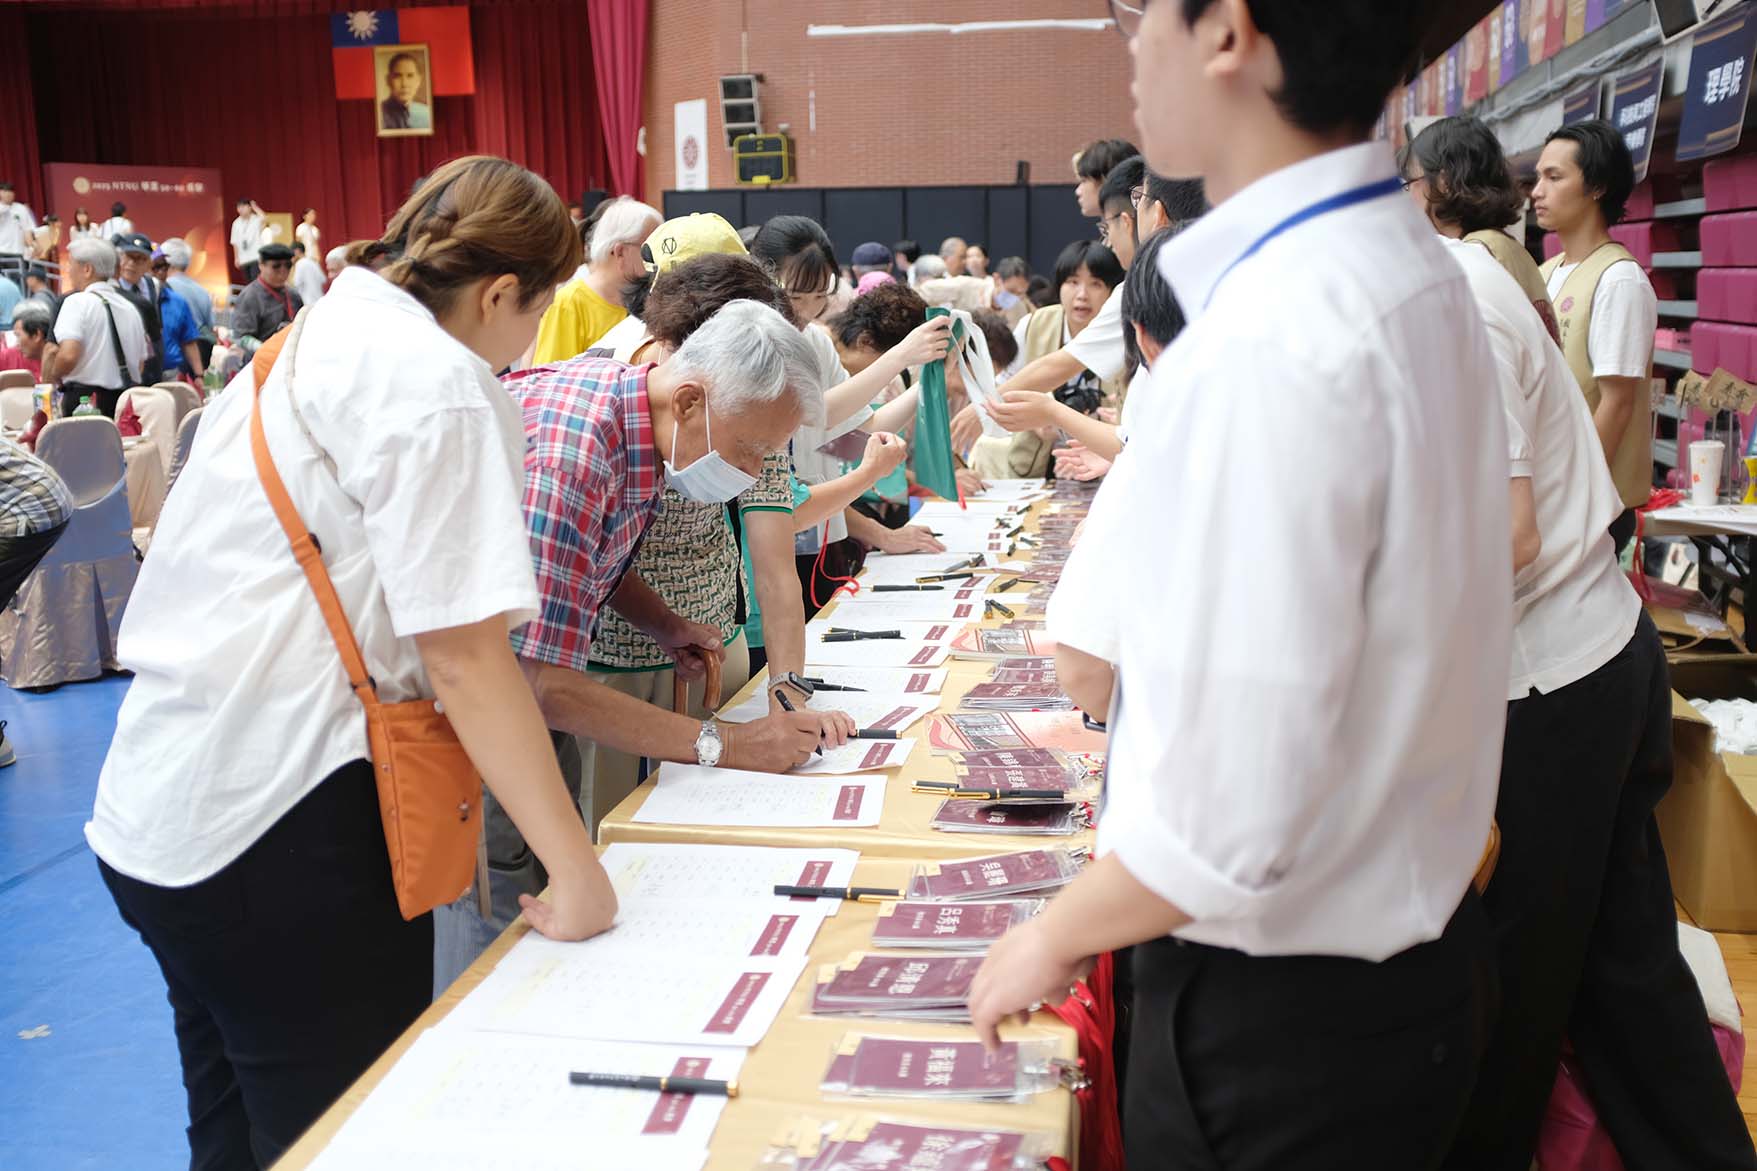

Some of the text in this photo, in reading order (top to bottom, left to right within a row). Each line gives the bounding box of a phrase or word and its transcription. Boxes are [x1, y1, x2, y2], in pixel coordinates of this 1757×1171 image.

[1703, 56, 1746, 105] 理學院
[111, 181, 139, 192] NTNU
[932, 907, 963, 934] 呂秀真
[923, 1047, 958, 1086] 黃福來
